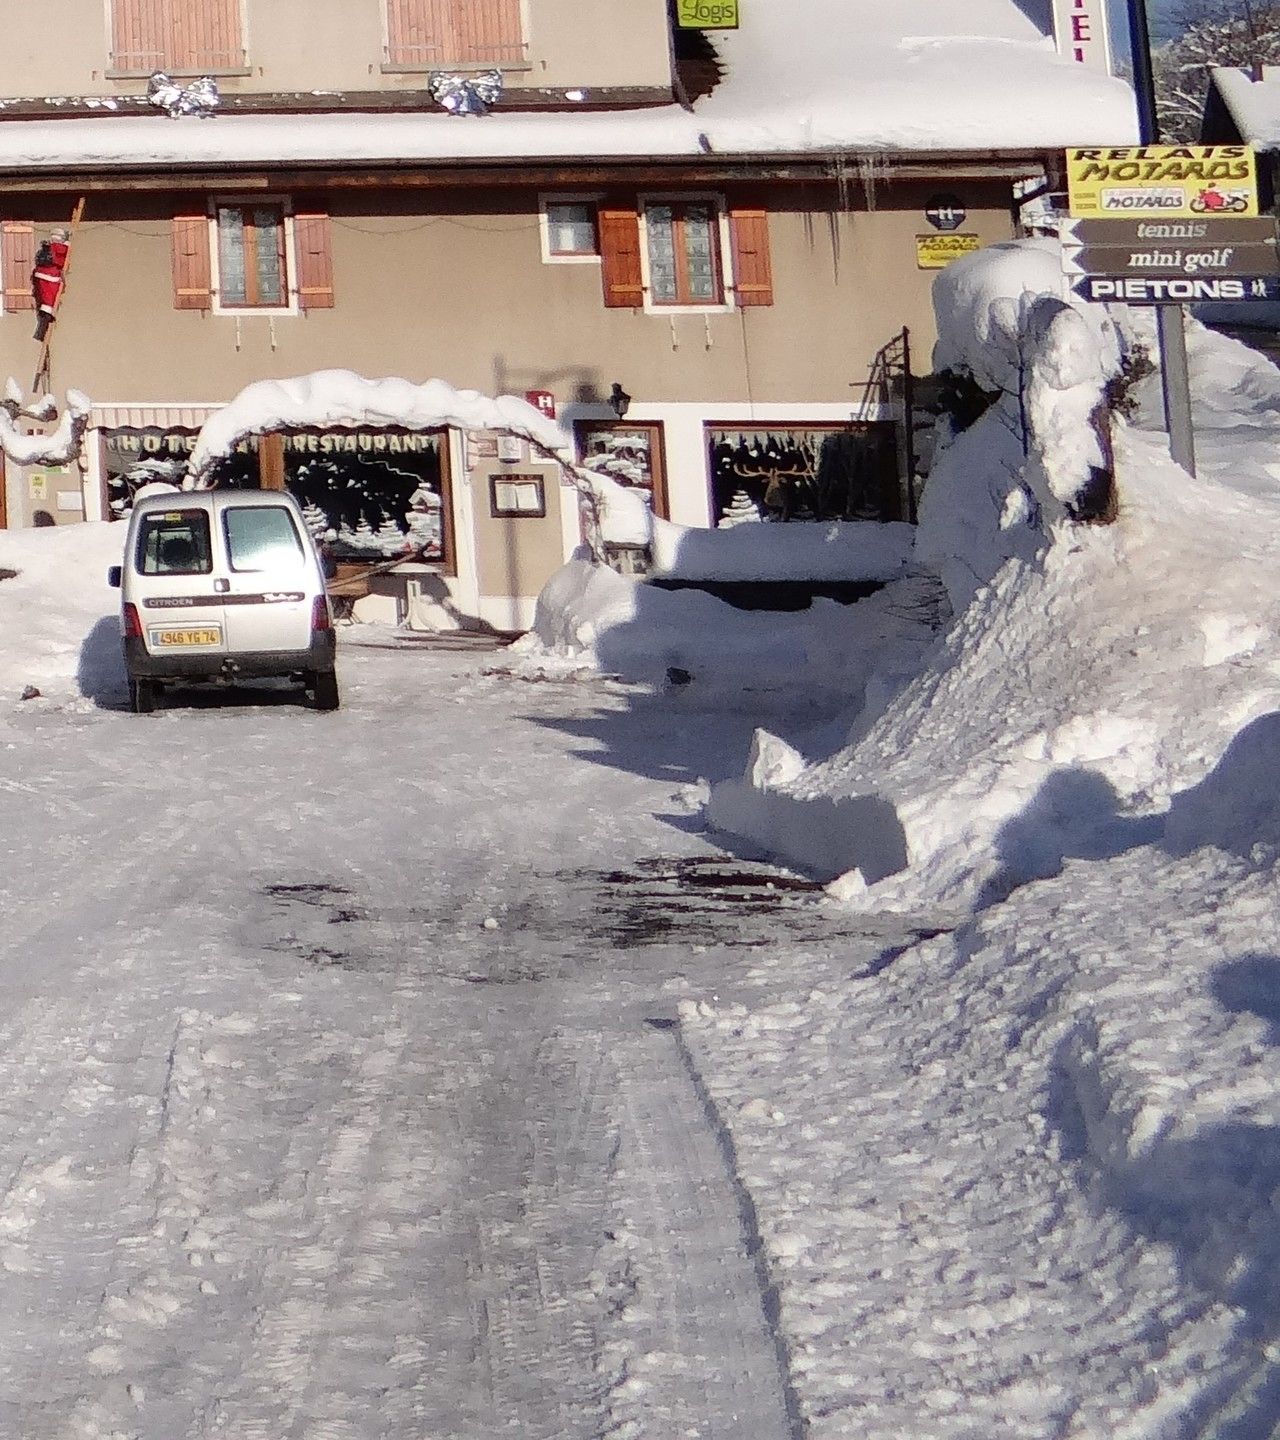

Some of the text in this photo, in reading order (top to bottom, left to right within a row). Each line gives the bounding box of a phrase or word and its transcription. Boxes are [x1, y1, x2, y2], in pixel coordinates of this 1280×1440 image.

[1073, 147, 1245, 161] RELAIS
[1076, 160, 1249, 182] MOTARDS
[1105, 196, 1183, 208] MOTARDS
[1137, 223, 1207, 239] tennis
[1127, 248, 1232, 273] mini golf
[292, 434, 430, 454] RESTAURANT
[203, 630, 217, 642] 74
